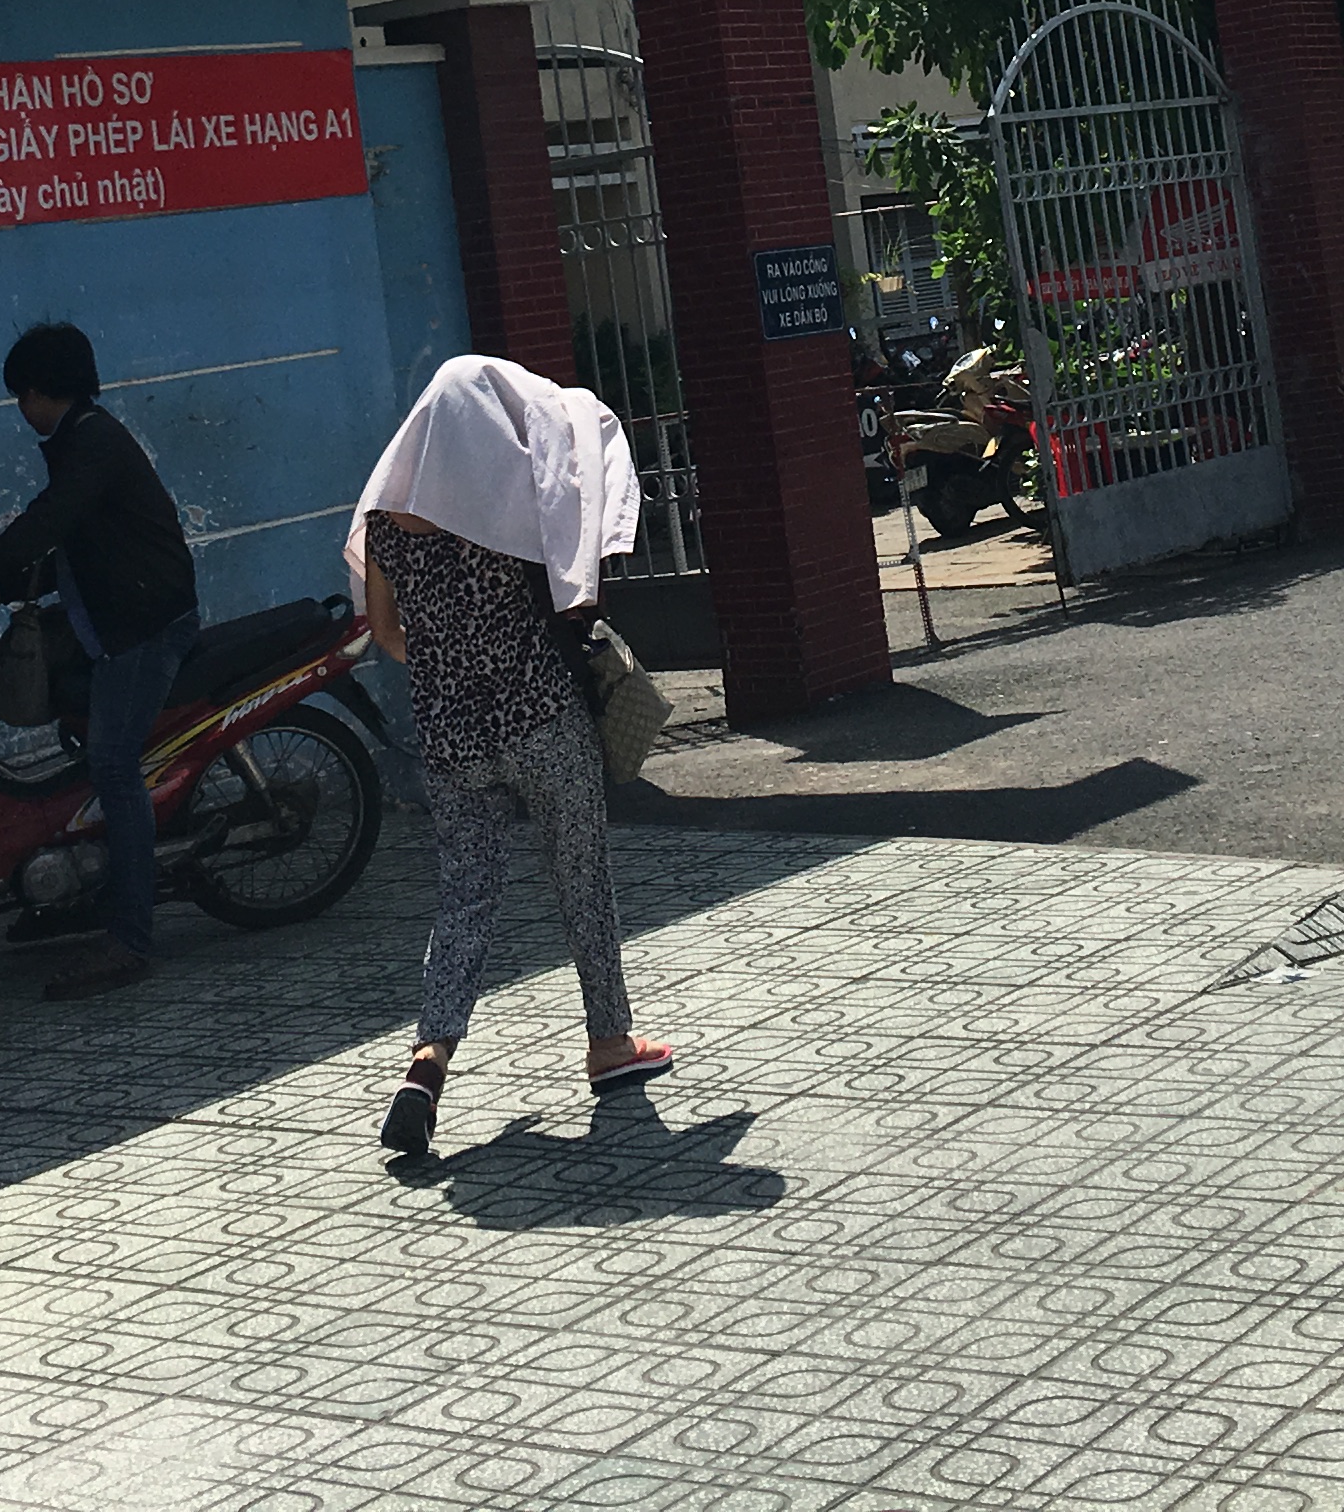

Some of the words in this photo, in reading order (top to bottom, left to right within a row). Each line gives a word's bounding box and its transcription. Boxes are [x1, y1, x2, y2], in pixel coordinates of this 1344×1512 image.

[62, 66, 104, 108] HỒ
[112, 71, 153, 106] SƠ
[69, 116, 143, 157] PHÉP
[152, 111, 195, 151] LÁI
[203, 115, 238, 147] XE
[246, 110, 318, 151] HẠNG
[325, 108, 354, 139] A1
[39, 171, 89, 210] chủ
[98, 168, 165, 209] nhật)
[766, 263, 782, 278] RA
[779, 312, 792, 328] XE
